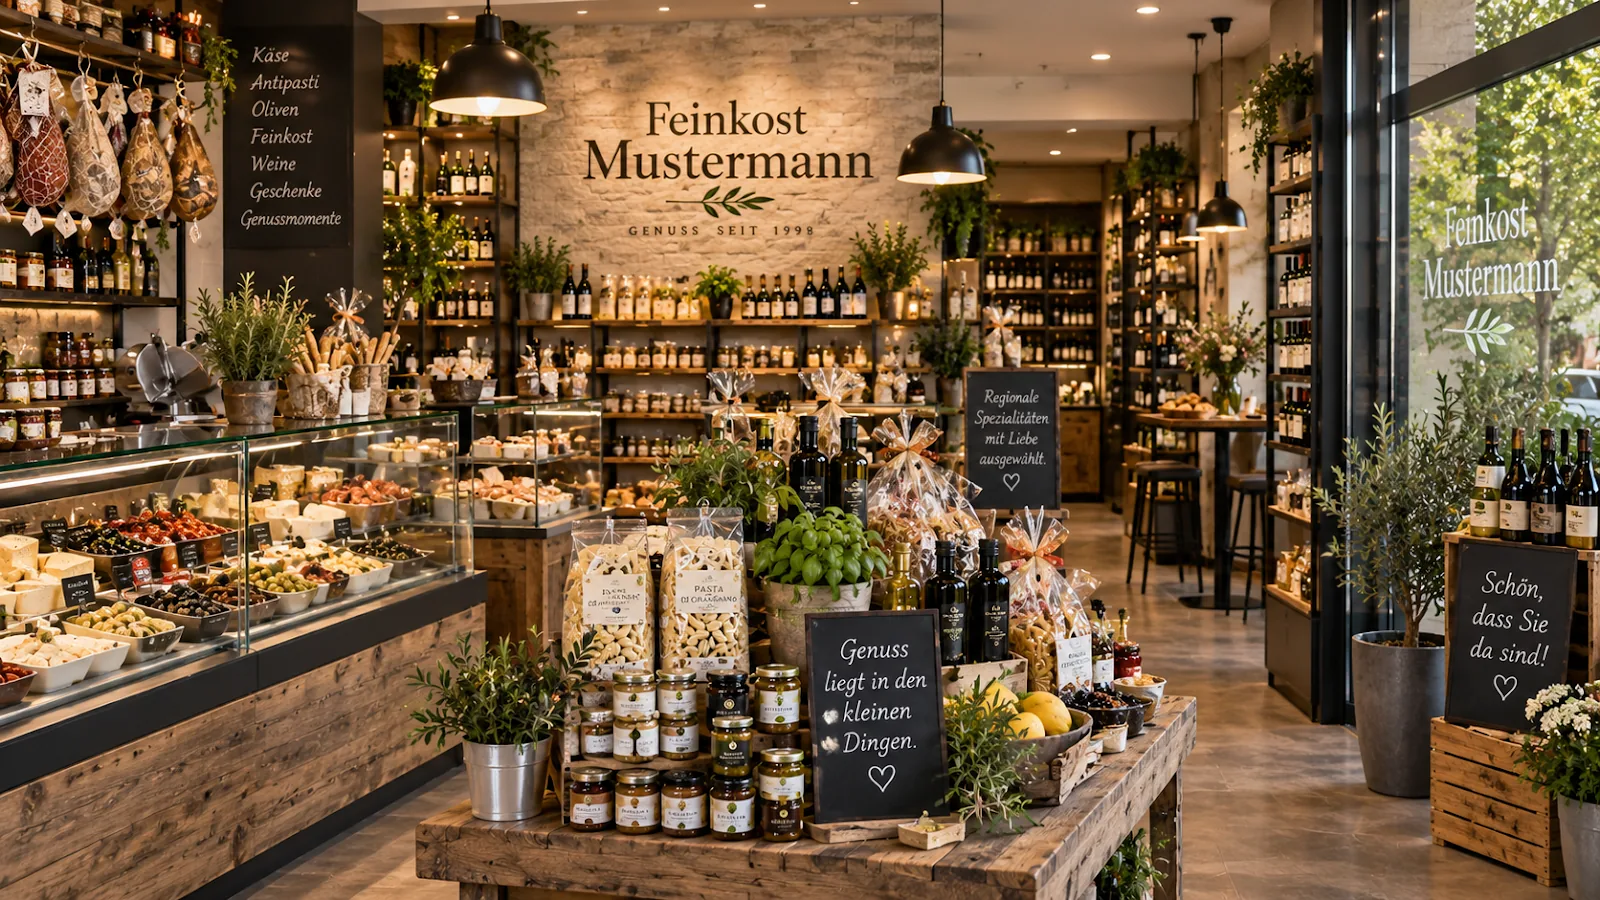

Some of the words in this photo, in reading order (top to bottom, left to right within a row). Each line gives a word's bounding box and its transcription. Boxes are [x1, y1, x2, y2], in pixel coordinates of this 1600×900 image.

[252, 46, 290, 63] Käse
[250, 74, 320, 95] Antipasti
[251, 100, 300, 118] Oliven
[646, 99, 808, 136] Feinkost
[250, 127, 314, 145] Feinkost
[251, 155, 297, 172] Weine
[582, 139, 875, 180] Mustermann
[249, 181, 323, 203] Geschenke
[240, 209, 342, 230] Genussmomente
[1444, 197, 1530, 249] Feinkost
[628, 225, 700, 236] GENUSS
[717, 225, 758, 236] SEIT
[773, 225, 815, 236] 1998
[1422, 257, 1562, 301] Mustermann
[984, 388, 1040, 409] Regionale
[974, 409, 1050, 429] Spezialitäten
[984, 431, 1006, 445] mit
[1008, 430, 1039, 446] Liebe
[979, 451, 1047, 470] ausgewählt.
[694, 585, 724, 593] PASTA
[1481, 570, 1543, 602] Schön,
[1472, 602, 1514, 630] dass
[1518, 608, 1549, 634] Sie
[840, 638, 909, 666] Genuss
[1469, 635, 1494, 660] da
[1498, 643, 1550, 667] sind!
[824, 670, 866, 699] liegt
[871, 671, 890, 690] in
[894, 666, 928, 690] den
[842, 700, 913, 723] kleinen
[842, 731, 918, 758] Dingen.
